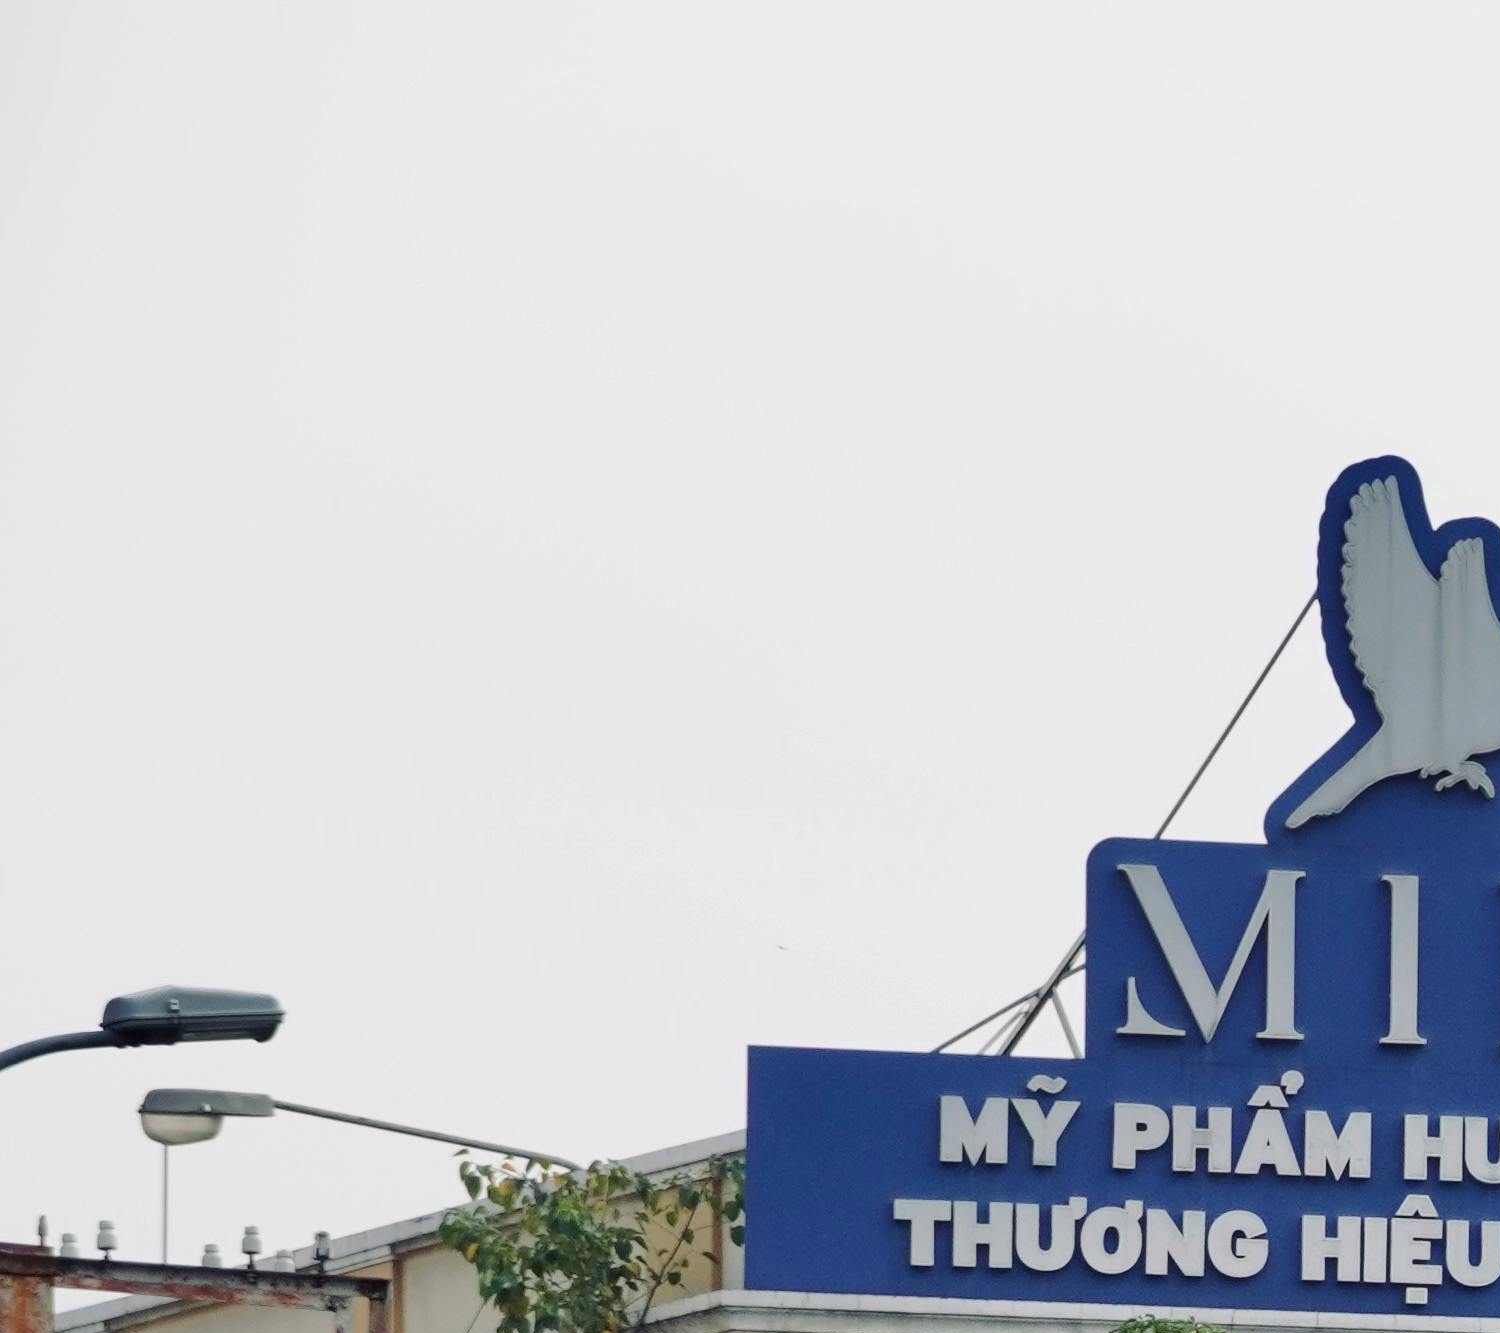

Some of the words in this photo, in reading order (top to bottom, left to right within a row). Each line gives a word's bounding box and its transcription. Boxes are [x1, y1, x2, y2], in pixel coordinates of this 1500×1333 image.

[938, 1076, 1082, 1168] MỸ
[1112, 1071, 1374, 1182] PHẨM
[893, 1194, 1269, 1281] THƯƠNG
